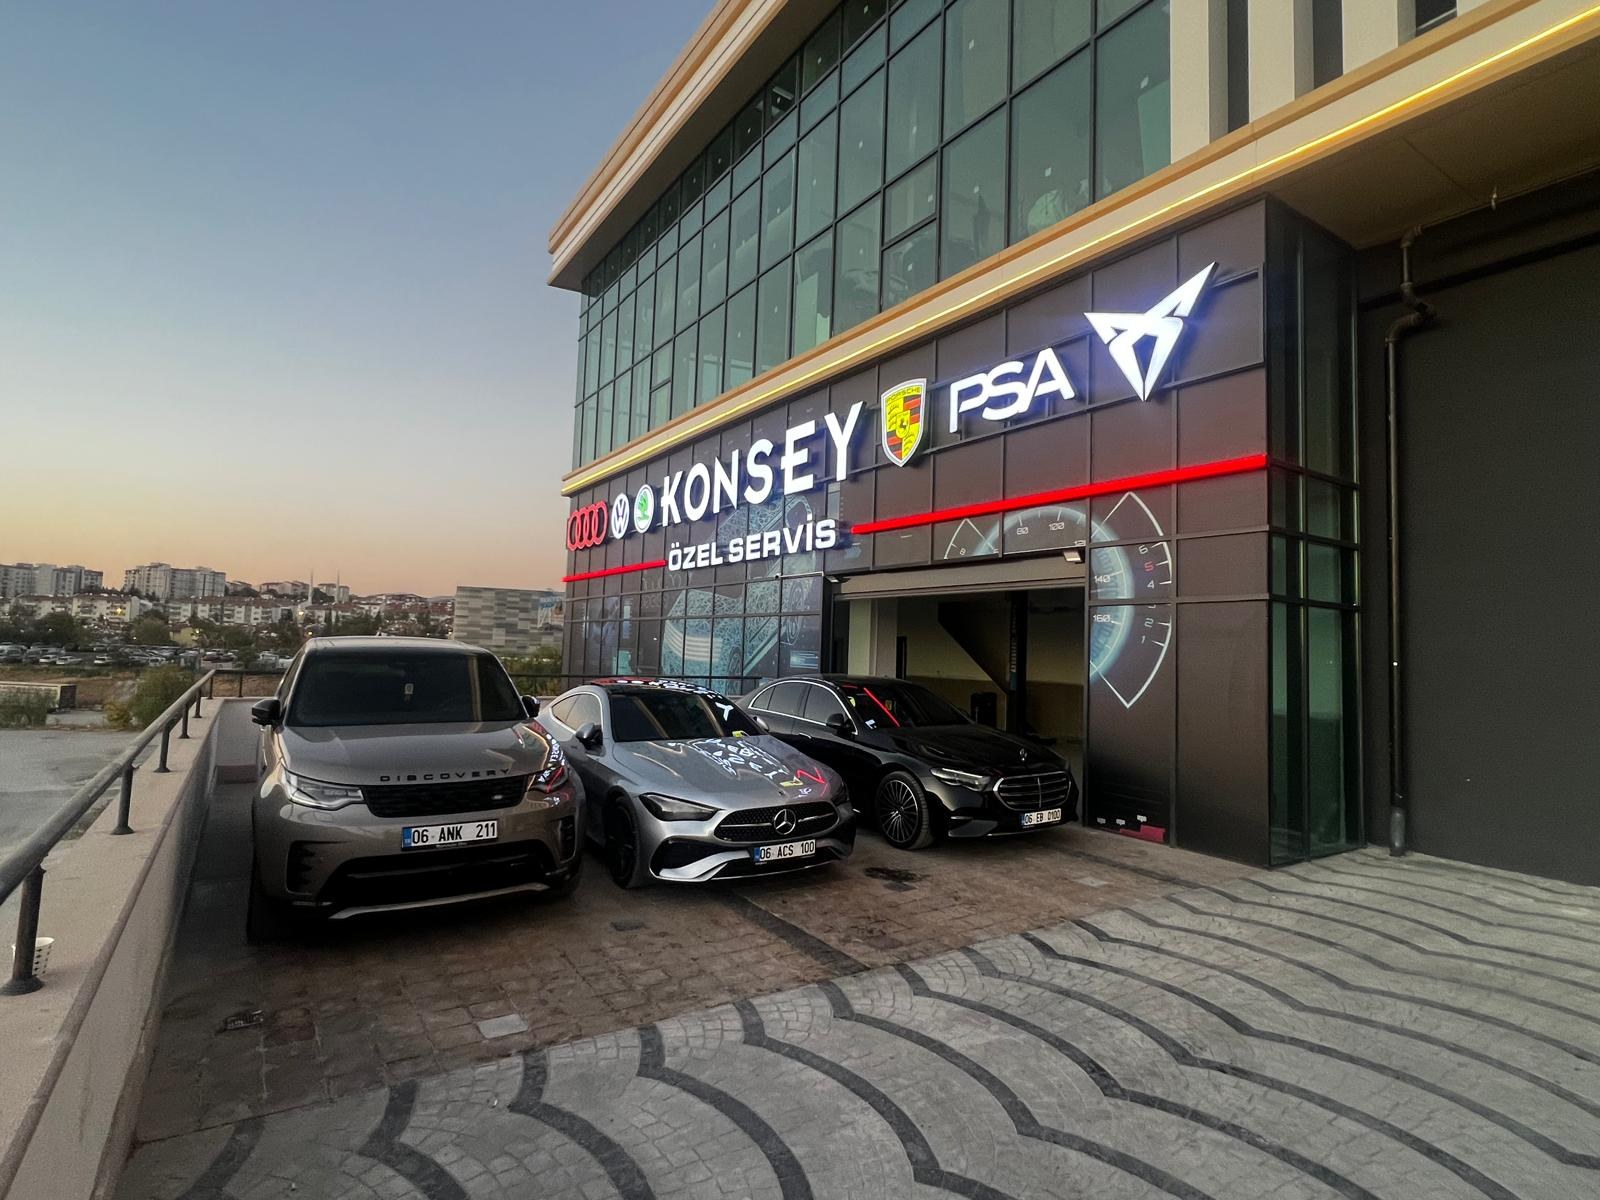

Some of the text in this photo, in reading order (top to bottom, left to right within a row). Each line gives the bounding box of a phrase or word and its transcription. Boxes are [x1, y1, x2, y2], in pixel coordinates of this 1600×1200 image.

[949, 347, 1075, 433] PSA
[661, 401, 865, 527] KONSEY
[1048, 521, 1065, 531] 100
[668, 513, 837, 572] ÖZEL SERVİS
[1144, 561, 1154, 572] 5
[1147, 580, 1155, 589] 4
[1144, 618, 1154, 628] 2
[380, 768, 510, 782] DISCOVERY
[1025, 814, 1032, 824] 06
[412, 823, 496, 844] 06 ANK 211
[760, 841, 815, 859] 06 ACS 100
